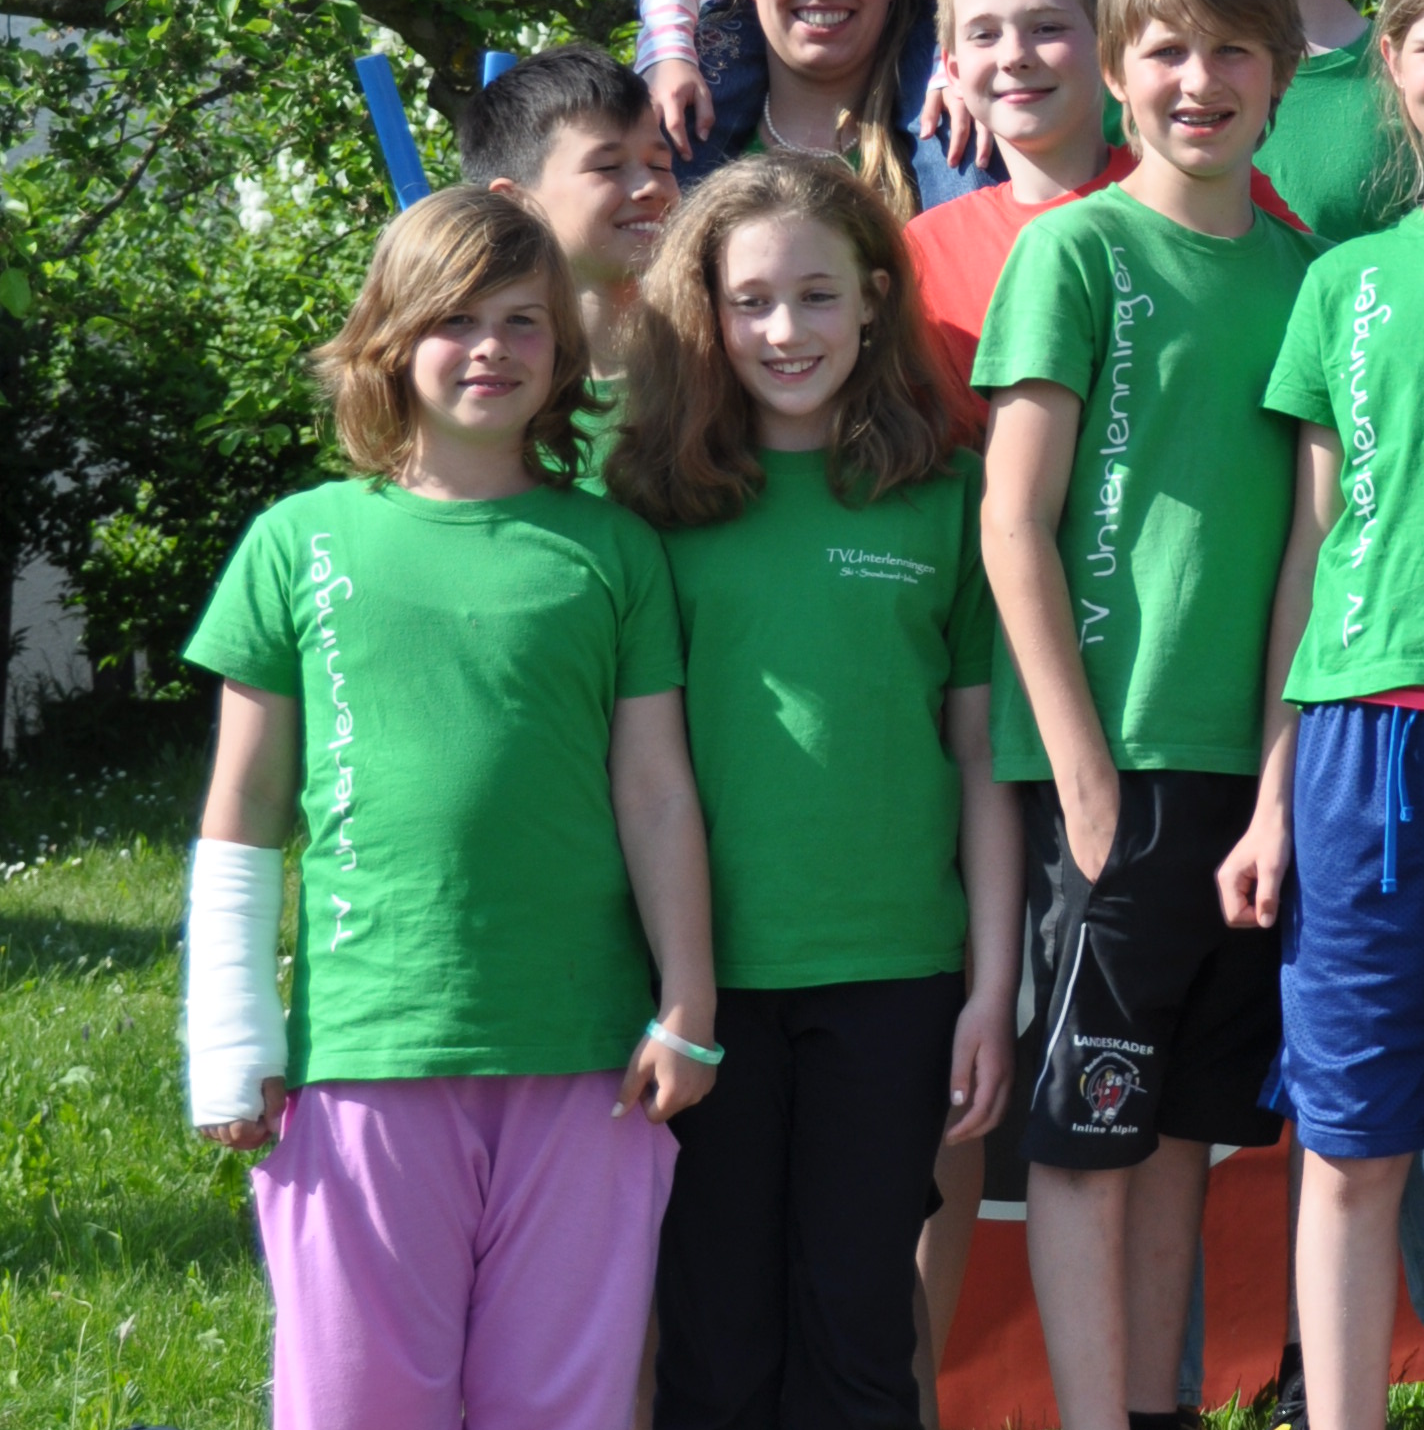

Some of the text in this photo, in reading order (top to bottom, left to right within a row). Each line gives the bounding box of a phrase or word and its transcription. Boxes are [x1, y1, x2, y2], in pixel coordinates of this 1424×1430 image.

[1080, 599, 1110, 651] TV
[1342, 593, 1364, 648] TV
[330, 894, 353, 952] TV
[1110, 1125, 1139, 1135] Alpin
